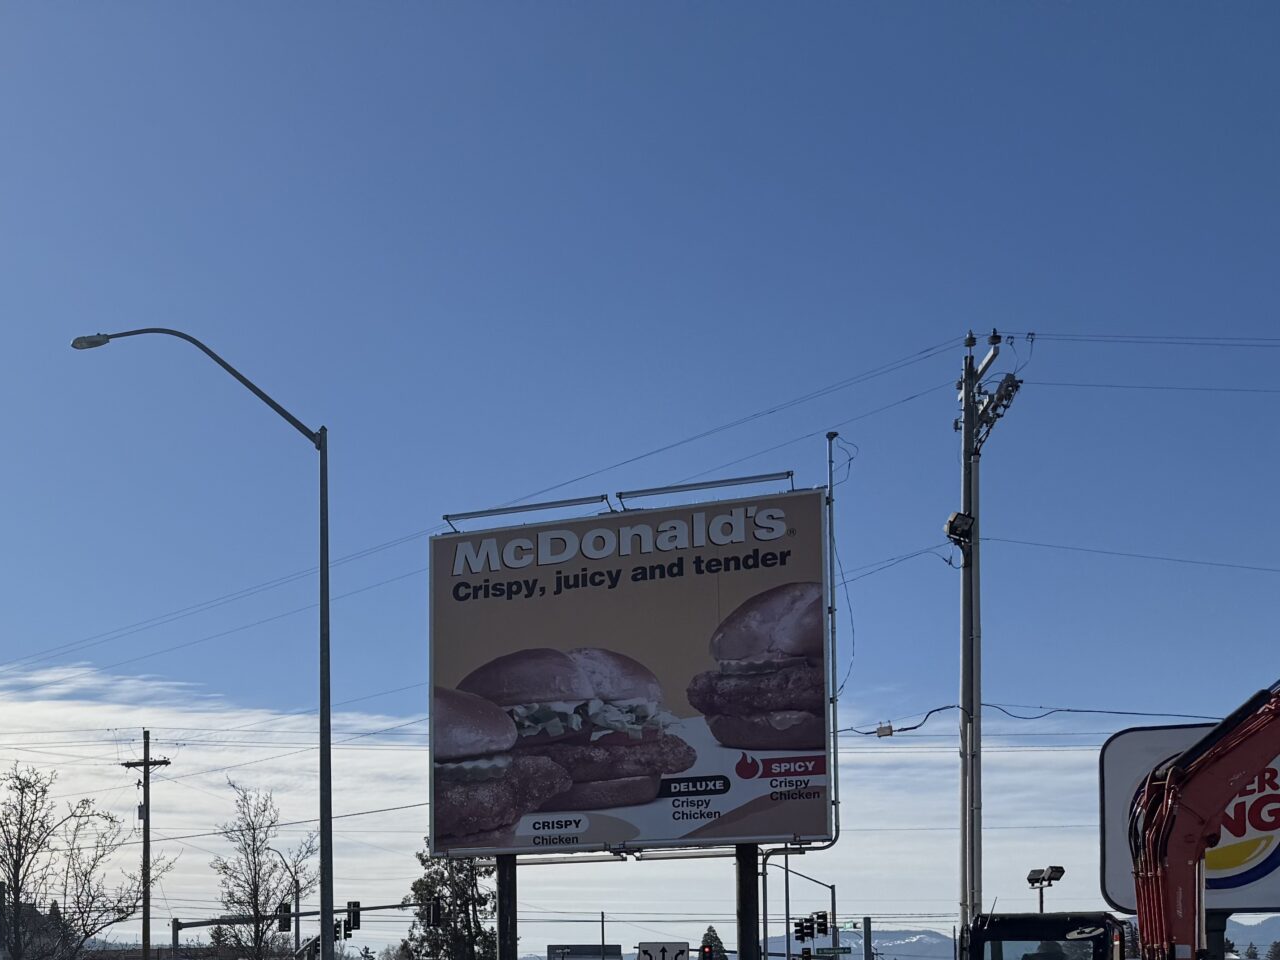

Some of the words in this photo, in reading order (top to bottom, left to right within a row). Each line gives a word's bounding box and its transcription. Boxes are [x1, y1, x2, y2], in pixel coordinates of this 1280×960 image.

[451, 506, 787, 576] McDonald's
[452, 578, 546, 601] Crispy,
[553, 567, 622, 595] juicy
[631, 557, 684, 582] and
[692, 548, 792, 575] tender
[770, 760, 815, 773] SPICY
[670, 780, 724, 793] DELUXE
[770, 778, 810, 790] Crispy
[770, 790, 820, 801] Chicken
[671, 797, 711, 810] Crispy
[671, 809, 721, 821] Chicken
[1219, 793, 1280, 838] NG
[531, 818, 582, 831] CRISPY
[532, 834, 579, 846] Chicken
